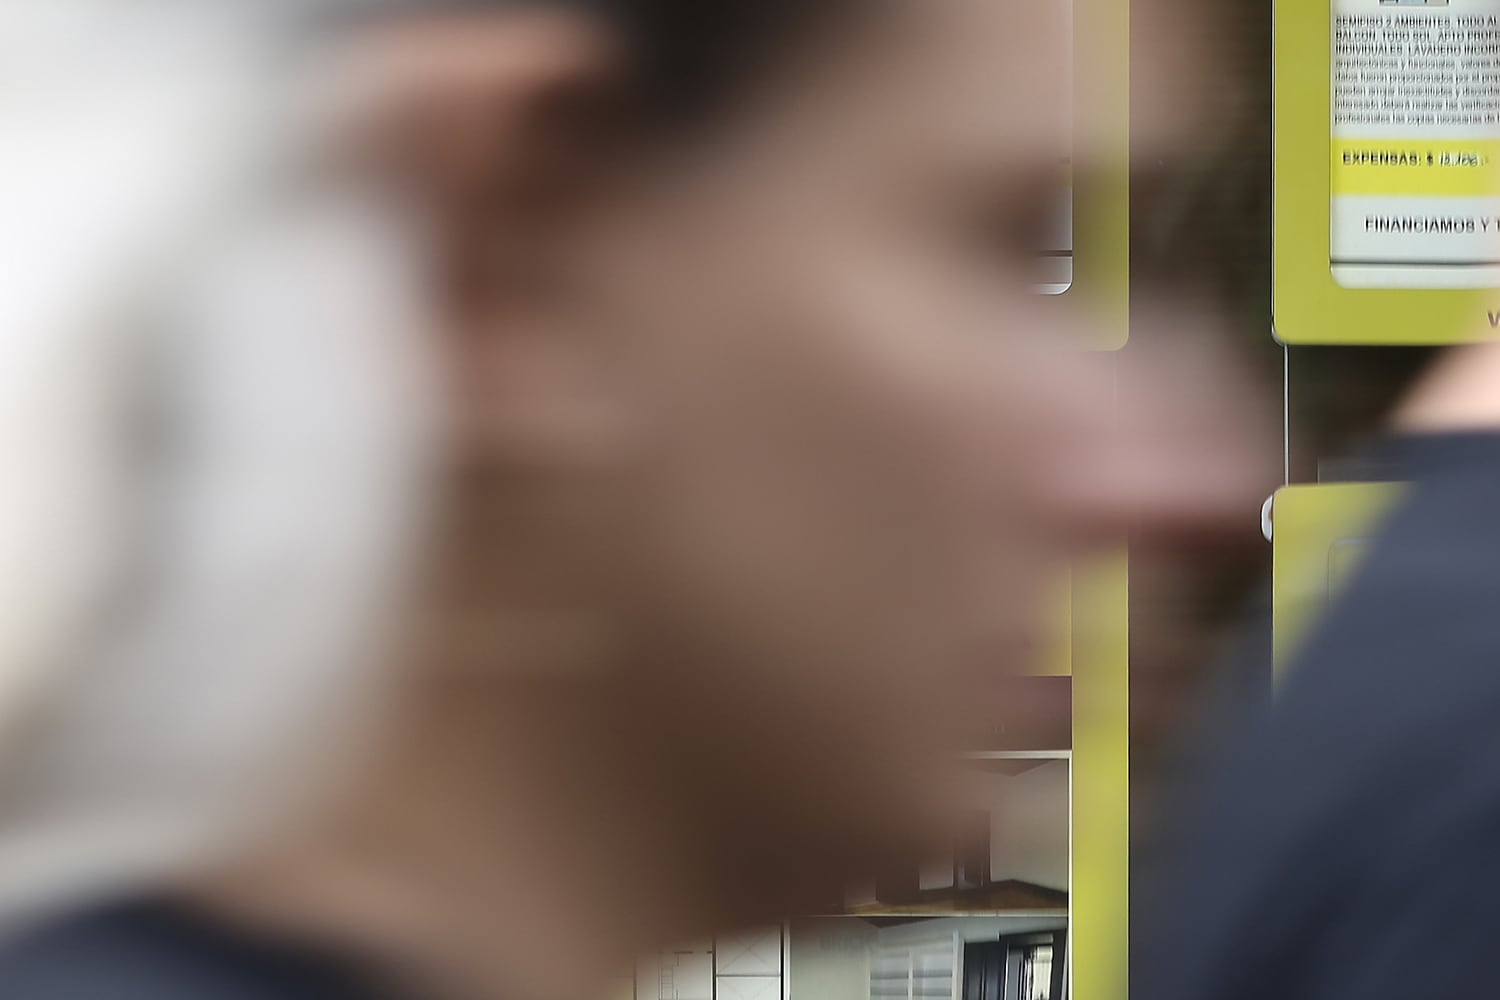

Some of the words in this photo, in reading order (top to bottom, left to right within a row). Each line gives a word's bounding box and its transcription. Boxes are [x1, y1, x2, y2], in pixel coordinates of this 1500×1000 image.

[1342, 151, 1421, 167] EXPENSAS:
[1426, 151, 1434, 167] $
[1366, 216, 1474, 234] FINANCIAMOS
[1481, 217, 1490, 234] Y
